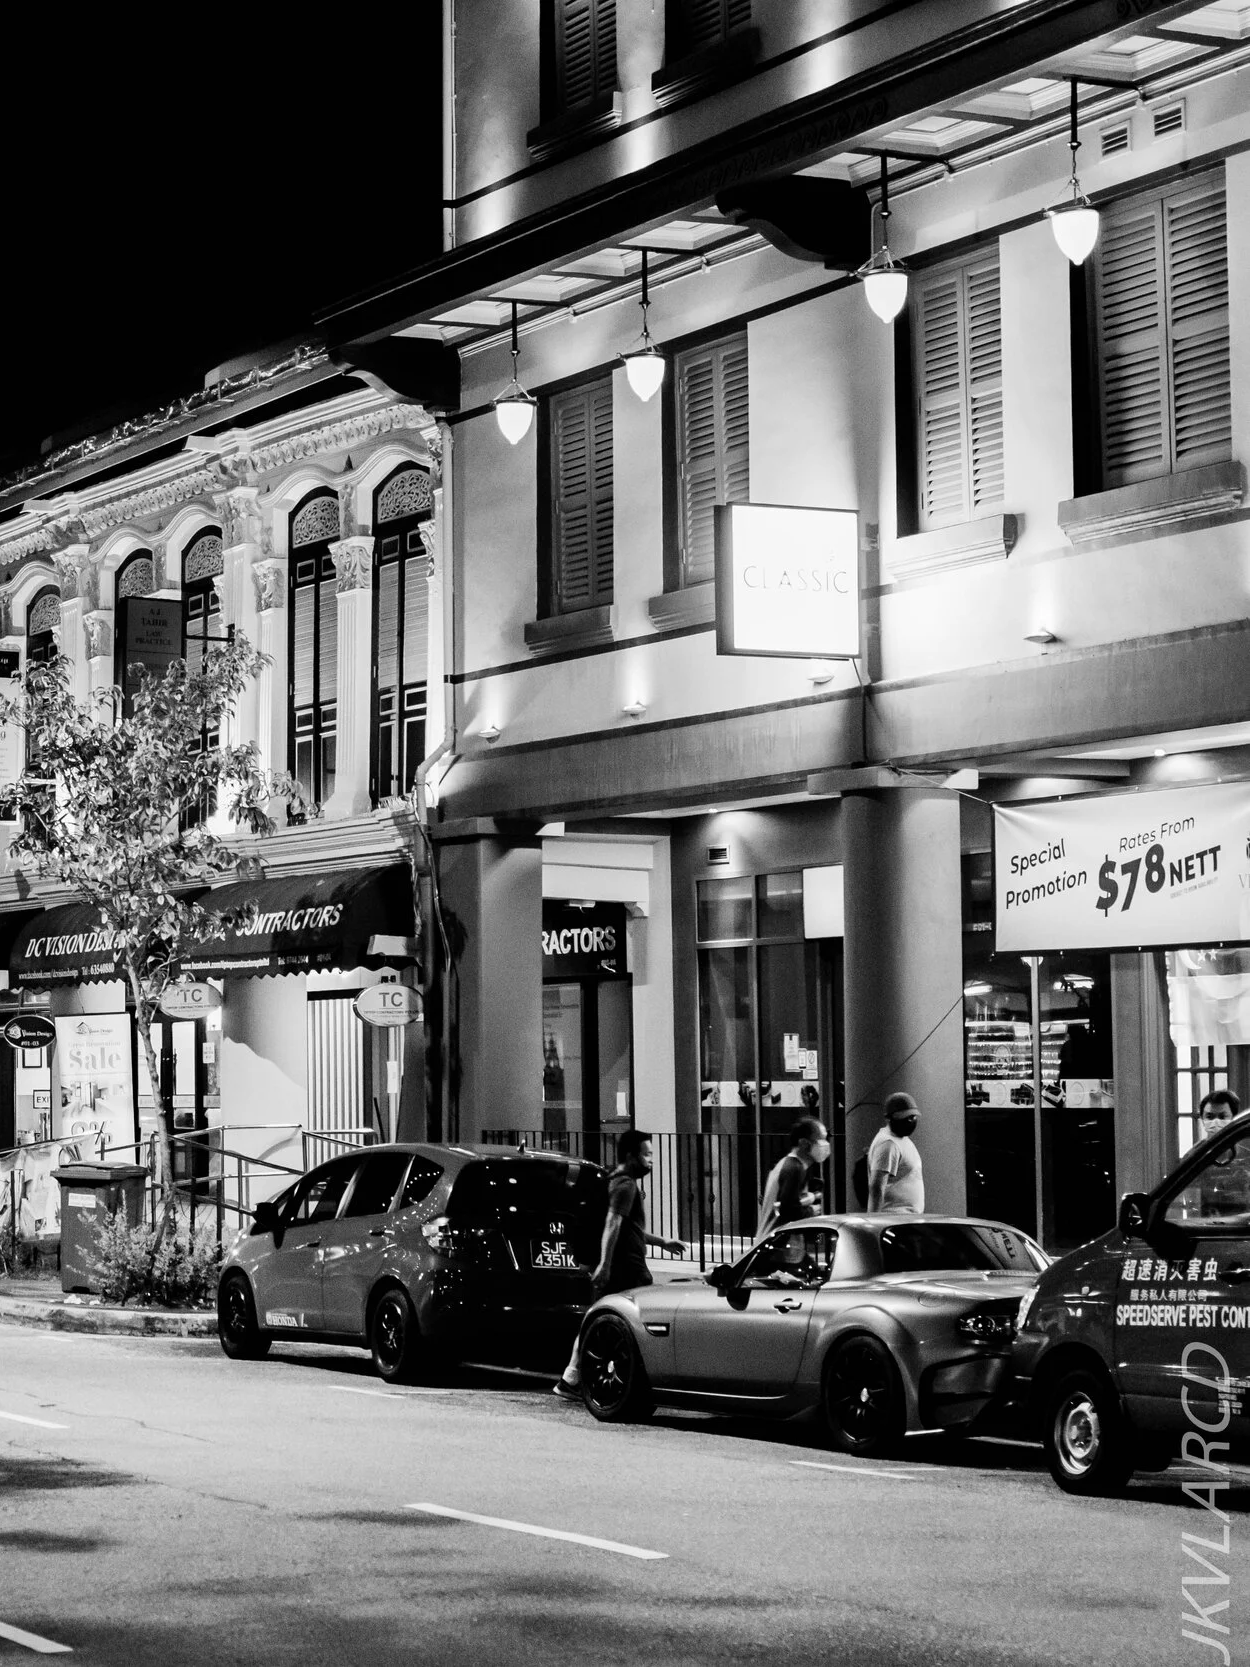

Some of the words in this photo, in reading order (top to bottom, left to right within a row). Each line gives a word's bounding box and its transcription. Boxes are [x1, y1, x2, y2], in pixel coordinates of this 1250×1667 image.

[743, 565, 849, 594] CLASSIC
[1119, 828, 1156, 853] Rates
[1160, 816, 1195, 839] From
[1010, 838, 1066, 876] Special
[1005, 869, 1088, 910] Promotion
[1095, 843, 1166, 918] $78
[1170, 845, 1222, 887] NETT
[45, 933, 85, 957] VISION
[542, 925, 617, 955] RACTORS
[179, 988, 202, 1003] TC
[378, 992, 403, 1007] TC
[69, 1047, 122, 1070] Sale
[36, 1096, 50, 1104] EXI
[541, 1241, 567, 1254] SJF
[535, 1253, 576, 1267] 4351K
[1130, 1288, 1208, 1301] 服务私人有限公司
[1116, 1304, 1187, 1326] SPEEDSERVE
[1189, 1305, 1219, 1328] PEST
